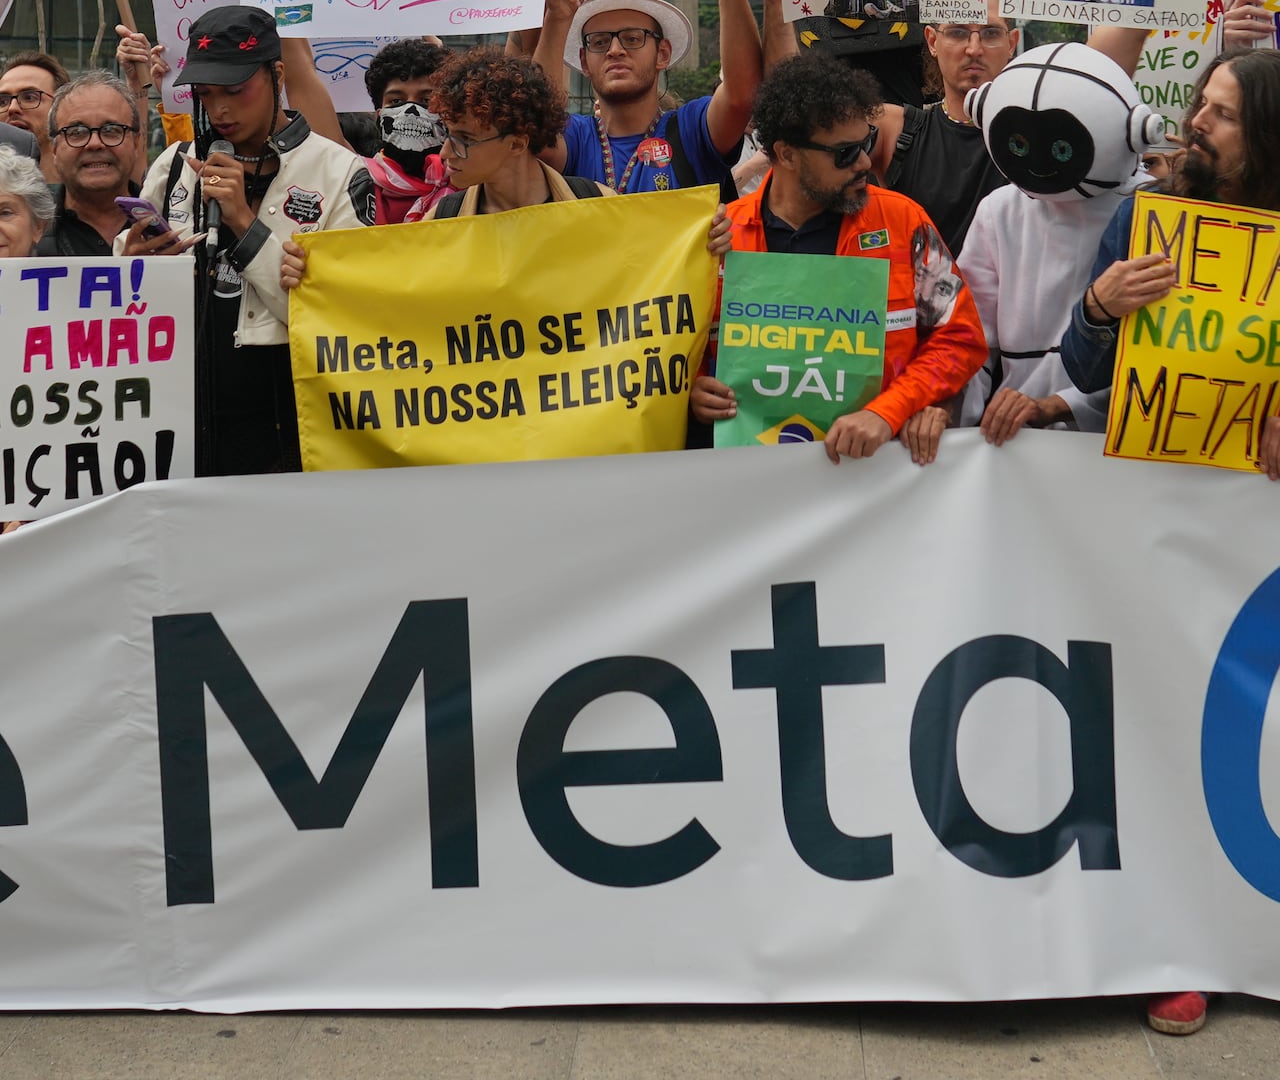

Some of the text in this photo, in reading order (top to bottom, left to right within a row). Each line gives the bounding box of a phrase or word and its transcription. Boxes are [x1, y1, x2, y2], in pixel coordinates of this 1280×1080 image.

[1133, 9, 1206, 27] SAFADO!
[23, 325, 54, 373] A
[67, 302, 176, 370] MÃO
[316, 293, 696, 375] Meta, NÃO SE META
[723, 322, 880, 356] DIGITAL
[726, 302, 880, 325] SOBERANIA
[1133, 295, 1220, 352] NÃO
[330, 347, 690, 430] NA NOSSA ELEIÇÃO!
[752, 357, 845, 402] JÁ!
[1114, 366, 1280, 469] META!
[151, 580, 1122, 908] Meta
